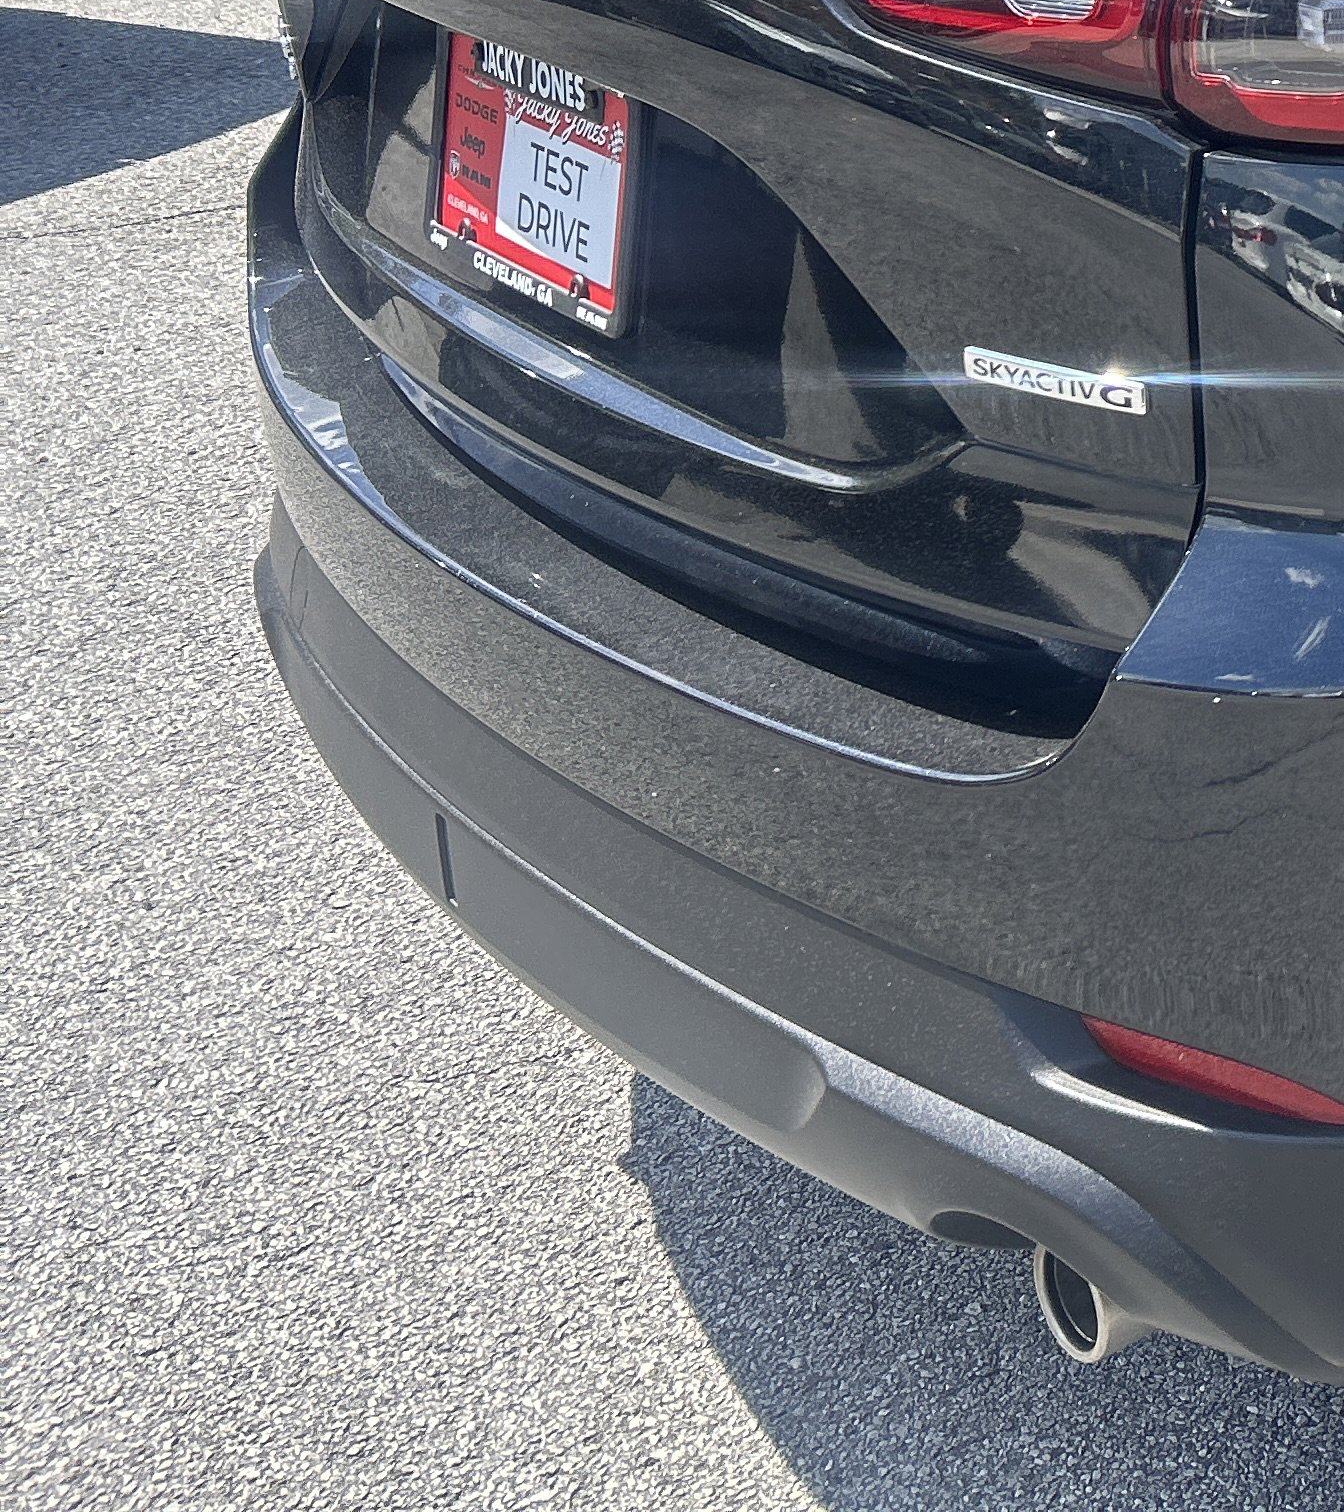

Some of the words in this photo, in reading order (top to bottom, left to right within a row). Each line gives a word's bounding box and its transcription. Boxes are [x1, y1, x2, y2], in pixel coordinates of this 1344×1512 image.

[482, 40, 525, 88] JACKY
[529, 58, 586, 112] JONES
[455, 92, 499, 125] DODGE
[562, 112, 609, 146] Jones
[460, 126, 486, 159] Jeep
[462, 163, 492, 190] RAM
[530, 141, 590, 203] TEST
[517, 192, 591, 264] DRIVE
[473, 251, 536, 297] CLEVELAND,
[536, 283, 553, 308] GA
